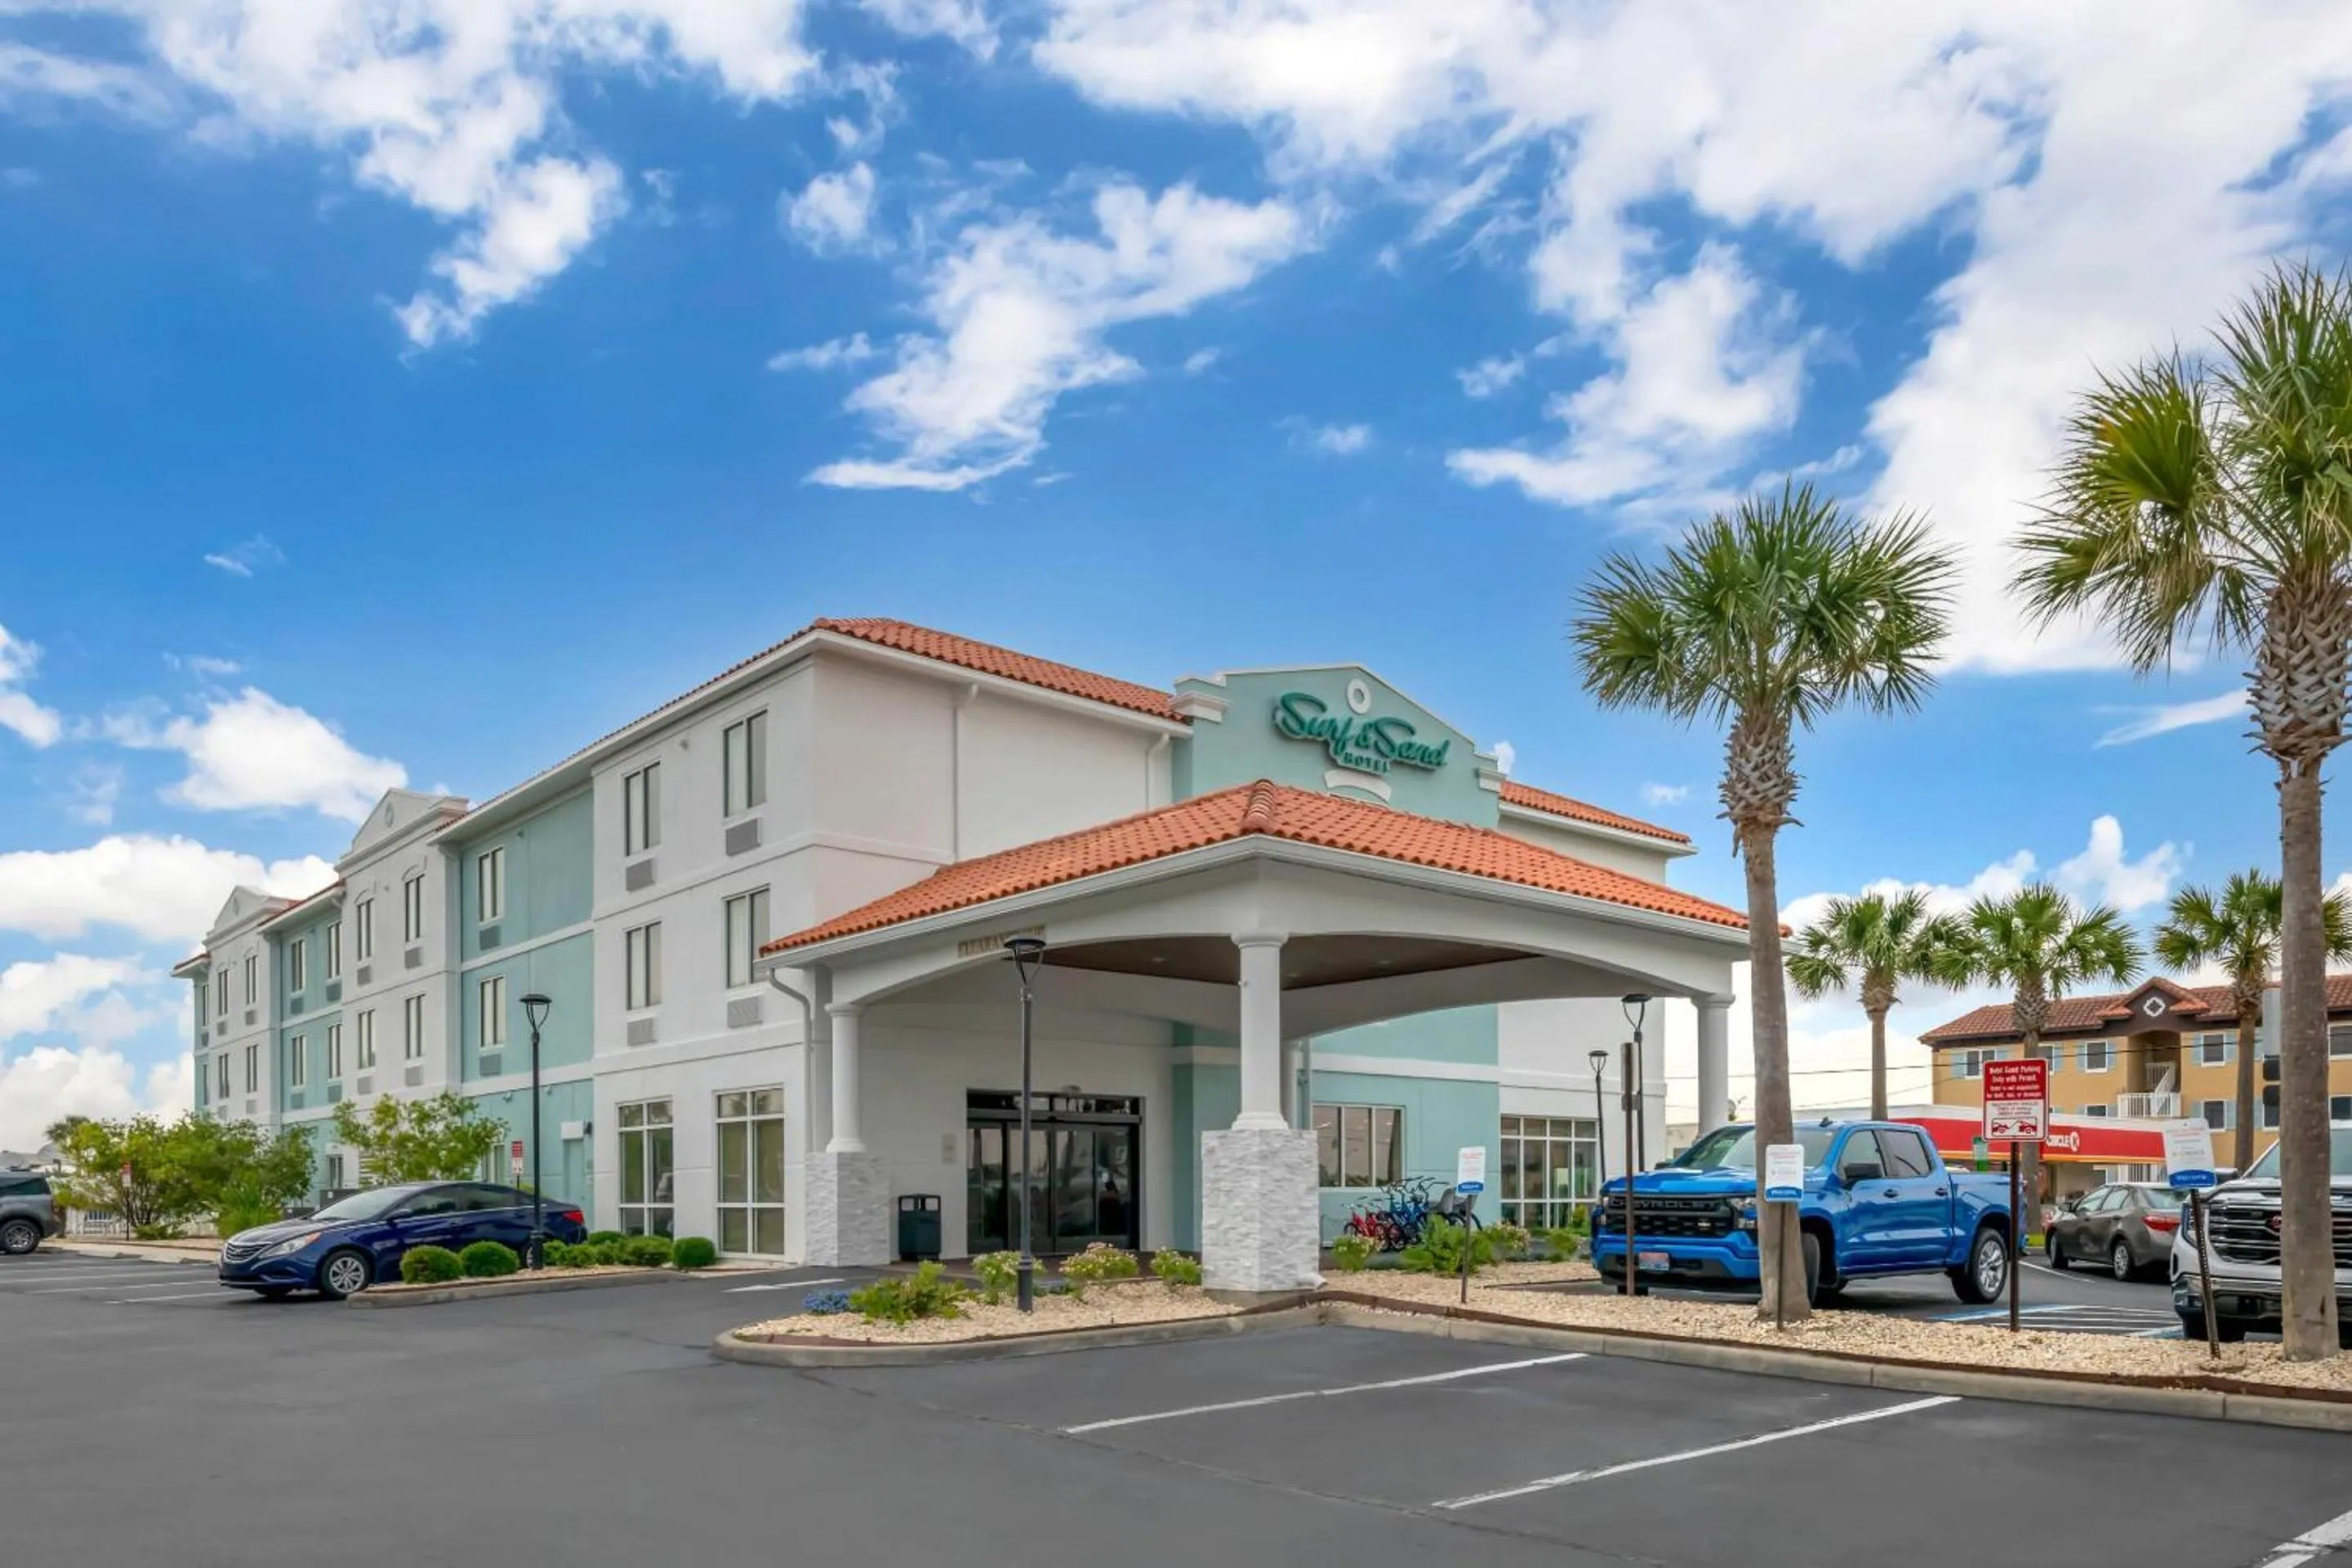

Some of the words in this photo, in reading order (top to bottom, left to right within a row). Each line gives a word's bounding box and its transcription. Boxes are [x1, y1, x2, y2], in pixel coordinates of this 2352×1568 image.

[1279, 693, 1354, 755] Surf
[1373, 716, 1450, 766] Sand
[1343, 752, 1388, 773] HOTEL
